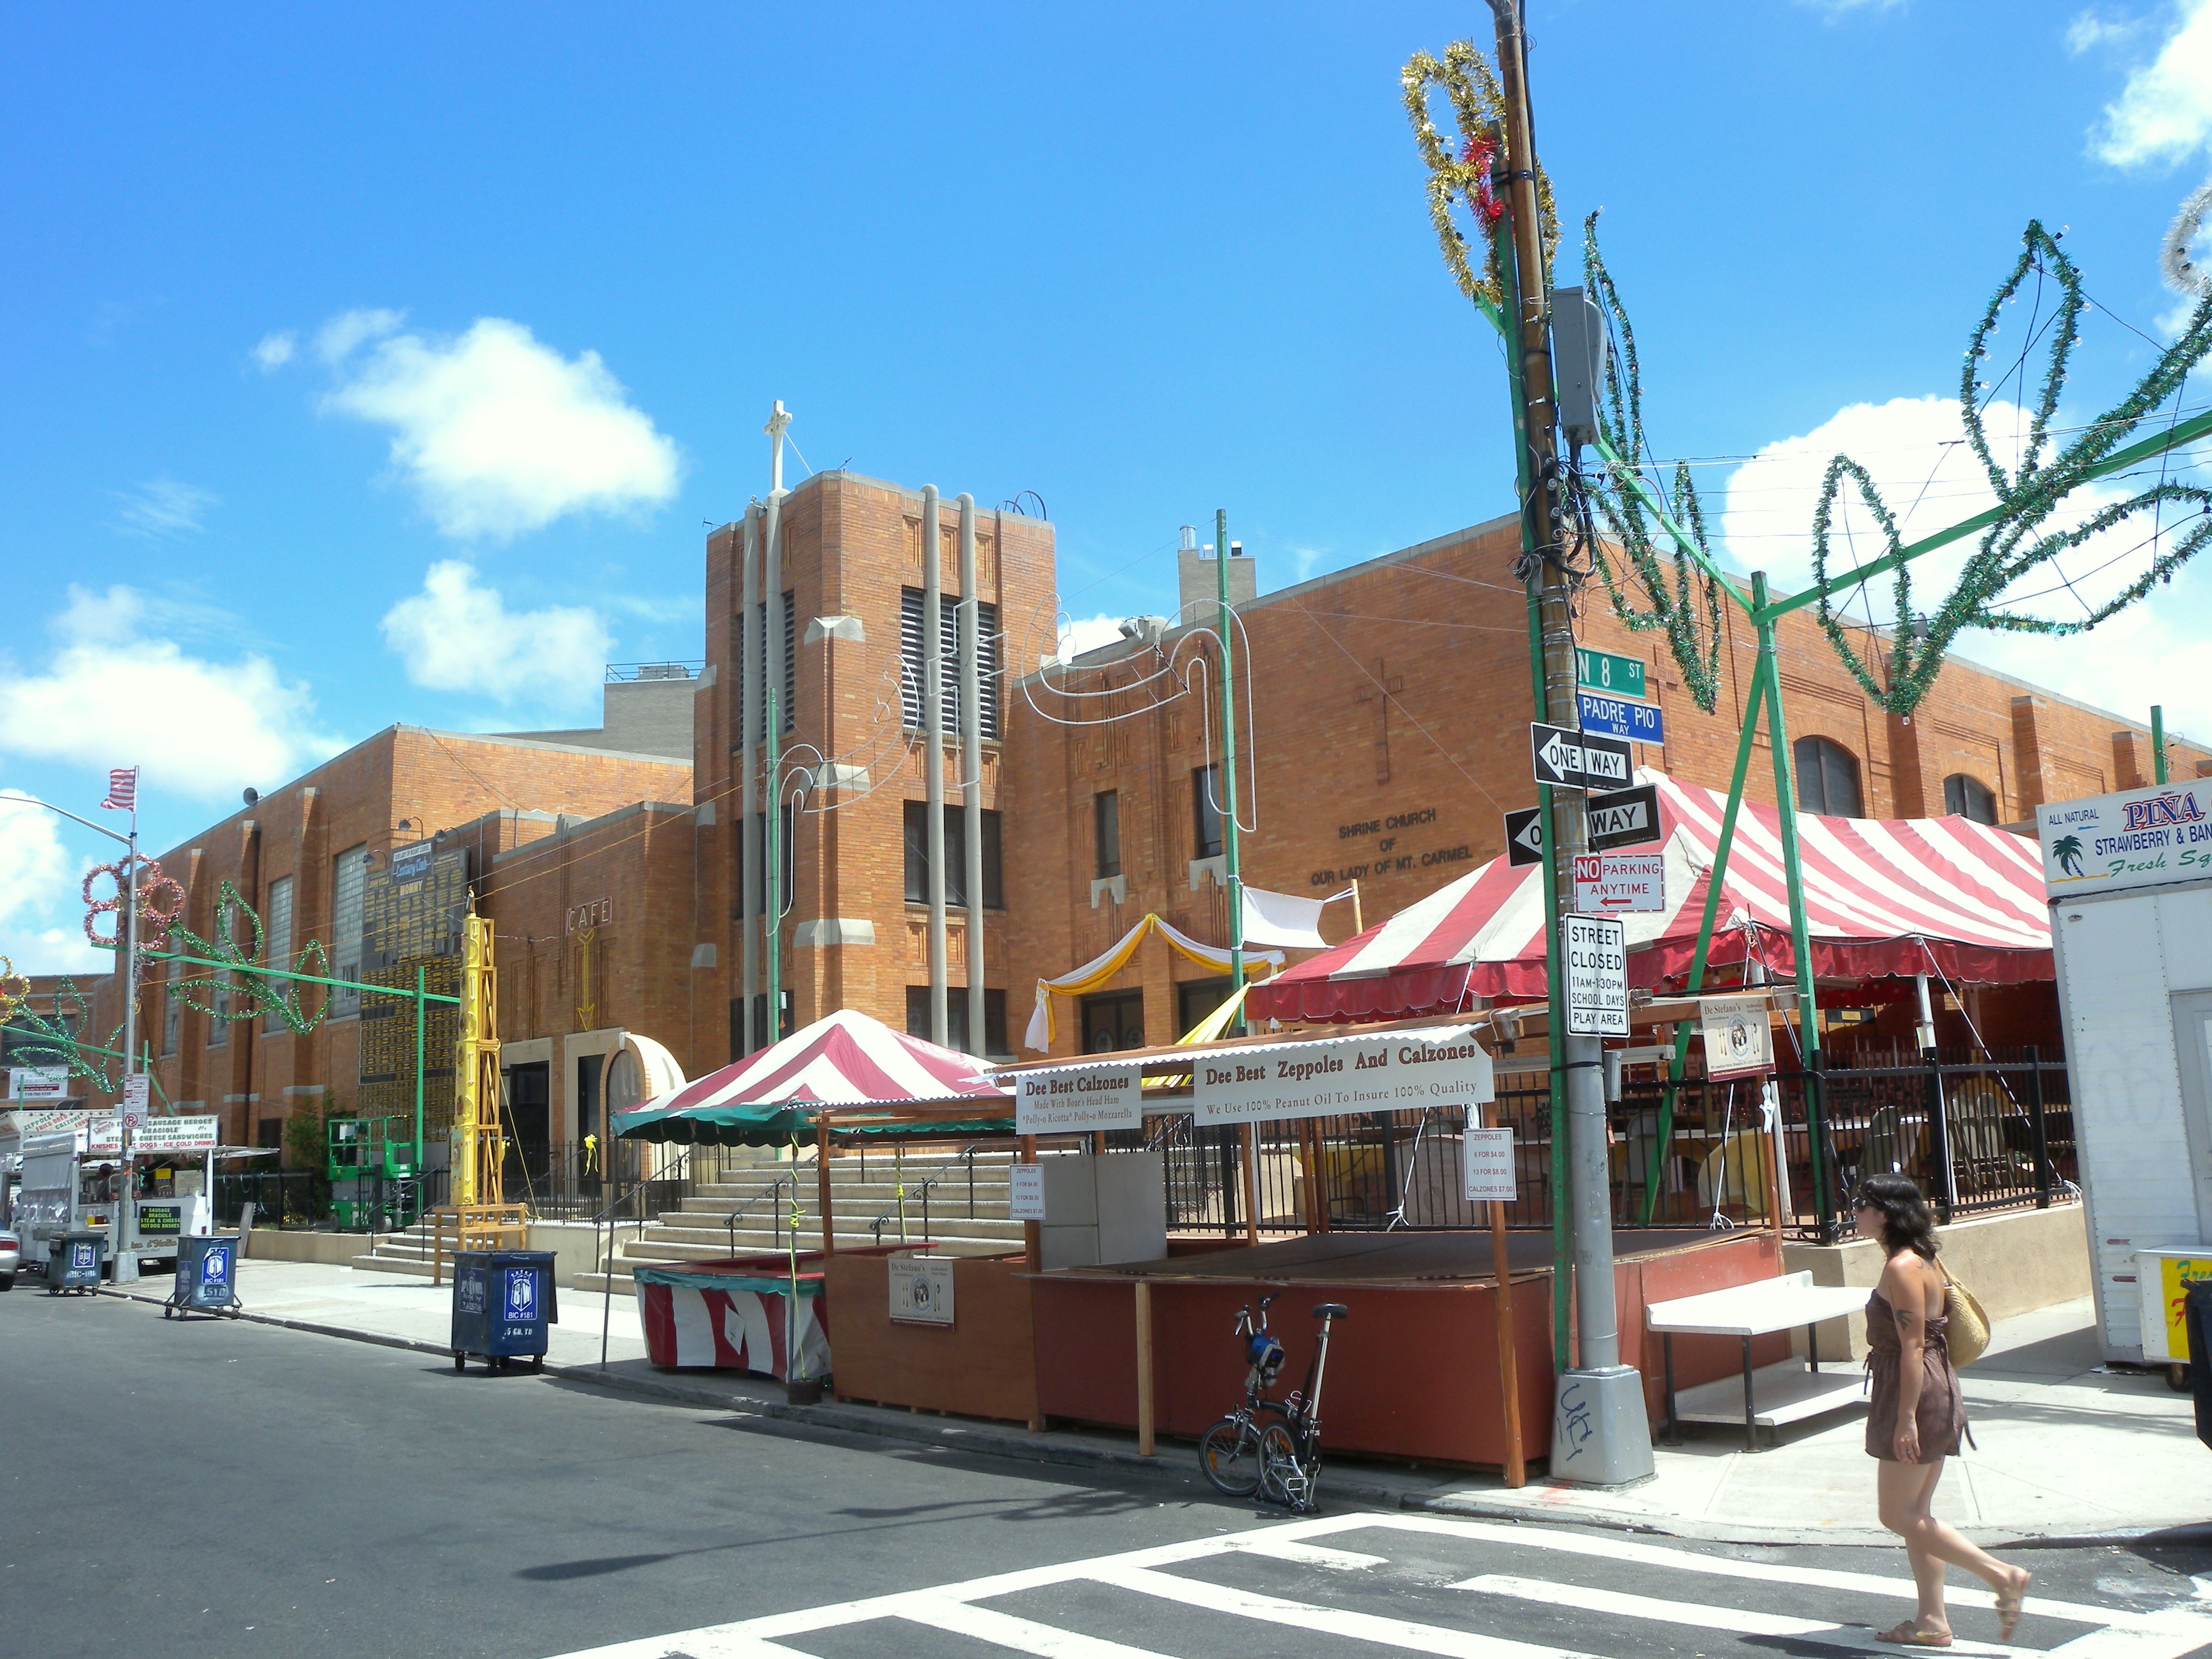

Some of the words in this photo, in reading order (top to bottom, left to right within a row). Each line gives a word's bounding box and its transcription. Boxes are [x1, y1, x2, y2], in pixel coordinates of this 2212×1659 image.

[1578, 651, 1589, 683] N
[1601, 657, 1610, 687] 8
[1629, 662, 1640, 679] ST
[1583, 697, 1627, 724] PADRE
[1634, 707, 1654, 728] PIO
[1612, 723, 1629, 735] WAY
[1550, 745, 1578, 769] ONE
[1591, 752, 1619, 776] WAY
[1591, 806, 1636, 834] WAY
[2049, 814, 2062, 825] ALL
[2065, 809, 2099, 824] NATURAL
[2122, 791, 2206, 832] PIÑA
[1339, 820, 1380, 839] SHRINE
[1386, 808, 1436, 830] CHURCH
[1379, 838, 1396, 853] OF
[2095, 830, 2170, 856] STRAWBERRY
[2176, 827, 2185, 844] &
[1312, 870, 1334, 886] OUR
[1340, 864, 1369, 880] LADY
[1375, 861, 1390, 875] OF
[1396, 855, 1415, 870] MT.
[1421, 845, 1472, 867] CARMEL
[1577, 859, 1600, 879] NO
[1603, 864, 1659, 875] PARKING
[2108, 851, 2166, 878] Fresh
[1590, 883, 1649, 895] ANYTIME
[569, 901, 609, 930] CAFE
[1572, 926, 1619, 945] STREET
[1571, 951, 1622, 970] CLOSED
[1572, 976, 1622, 990] 11AM-1:30PM
[1572, 992, 1603, 1005] SCHOOL
[1607, 995, 1624, 1006] DAYS
[1574, 1012, 1596, 1024] PLAY
[1601, 1014, 1623, 1025] AREA
[1705, 1005, 1712, 1015] De
[1715, 1003, 1741, 1014] Stefano's
[1206, 1068, 1231, 1085] Dee
[1236, 1066, 1266, 1082] Best
[1278, 1055, 1343, 1081] Zeppoles
[1355, 1048, 1388, 1069] And
[1398, 1044, 1475, 1064] Calzones
[1026, 1081, 1046, 1096] Dee
[1050, 1079, 1074, 1094] Best
[1077, 1075, 1129, 1092] Calzones
[1034, 1100, 1049, 1110] Made
[1050, 1099, 1065, 1108] With
[1067, 1097, 1085, 1107] Boar's
[1087, 1096, 1102, 1105] Head
[1104, 1096, 1119, 1104] Ham
[1207, 1105, 1221, 1115] We
[1225, 1103, 1241, 1113] Use
[1246, 1099, 1271, 1112] 100%
[1276, 1097, 1310, 1109] Peanut
[1314, 1092, 1331, 1105] Oil
[1335, 1092, 1349, 1103] To
[1354, 1090, 1389, 1101] Insure
[1395, 1085, 1424, 1098] 100%
[1430, 1080, 1477, 1097] Quality
[23, 1115, 52, 1131] ZEPPOLE
[55, 1115, 82, 1130] CALZONE
[1074, 1111, 1096, 1123] Polly-o
[1098, 1108, 1132, 1120] Mozzarella
